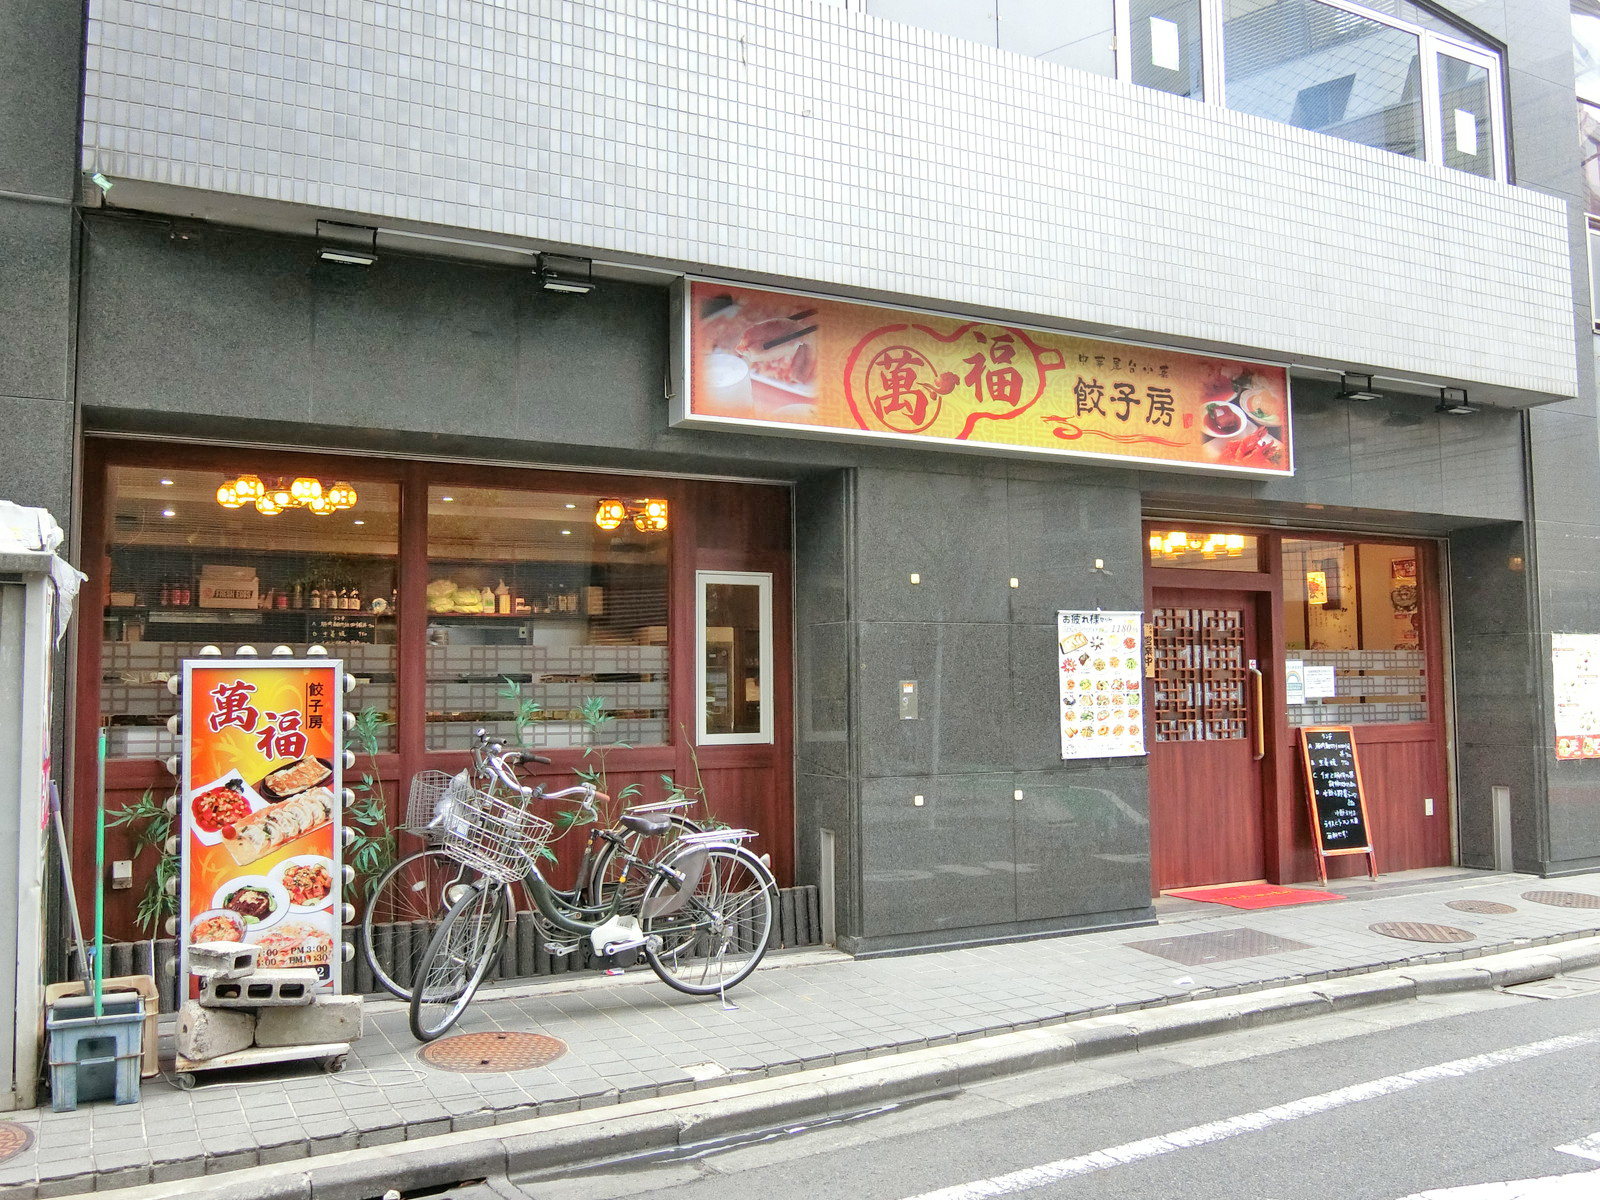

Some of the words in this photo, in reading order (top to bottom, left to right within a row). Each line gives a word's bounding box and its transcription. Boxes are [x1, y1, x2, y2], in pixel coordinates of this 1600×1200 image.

[874, 331, 1024, 426] 萬福
[1073, 376, 1175, 427] 餃子房
[208, 679, 308, 761] 萬福
[308, 682, 324, 729] 餃子房
[306, 944, 328, 953] 3:00
